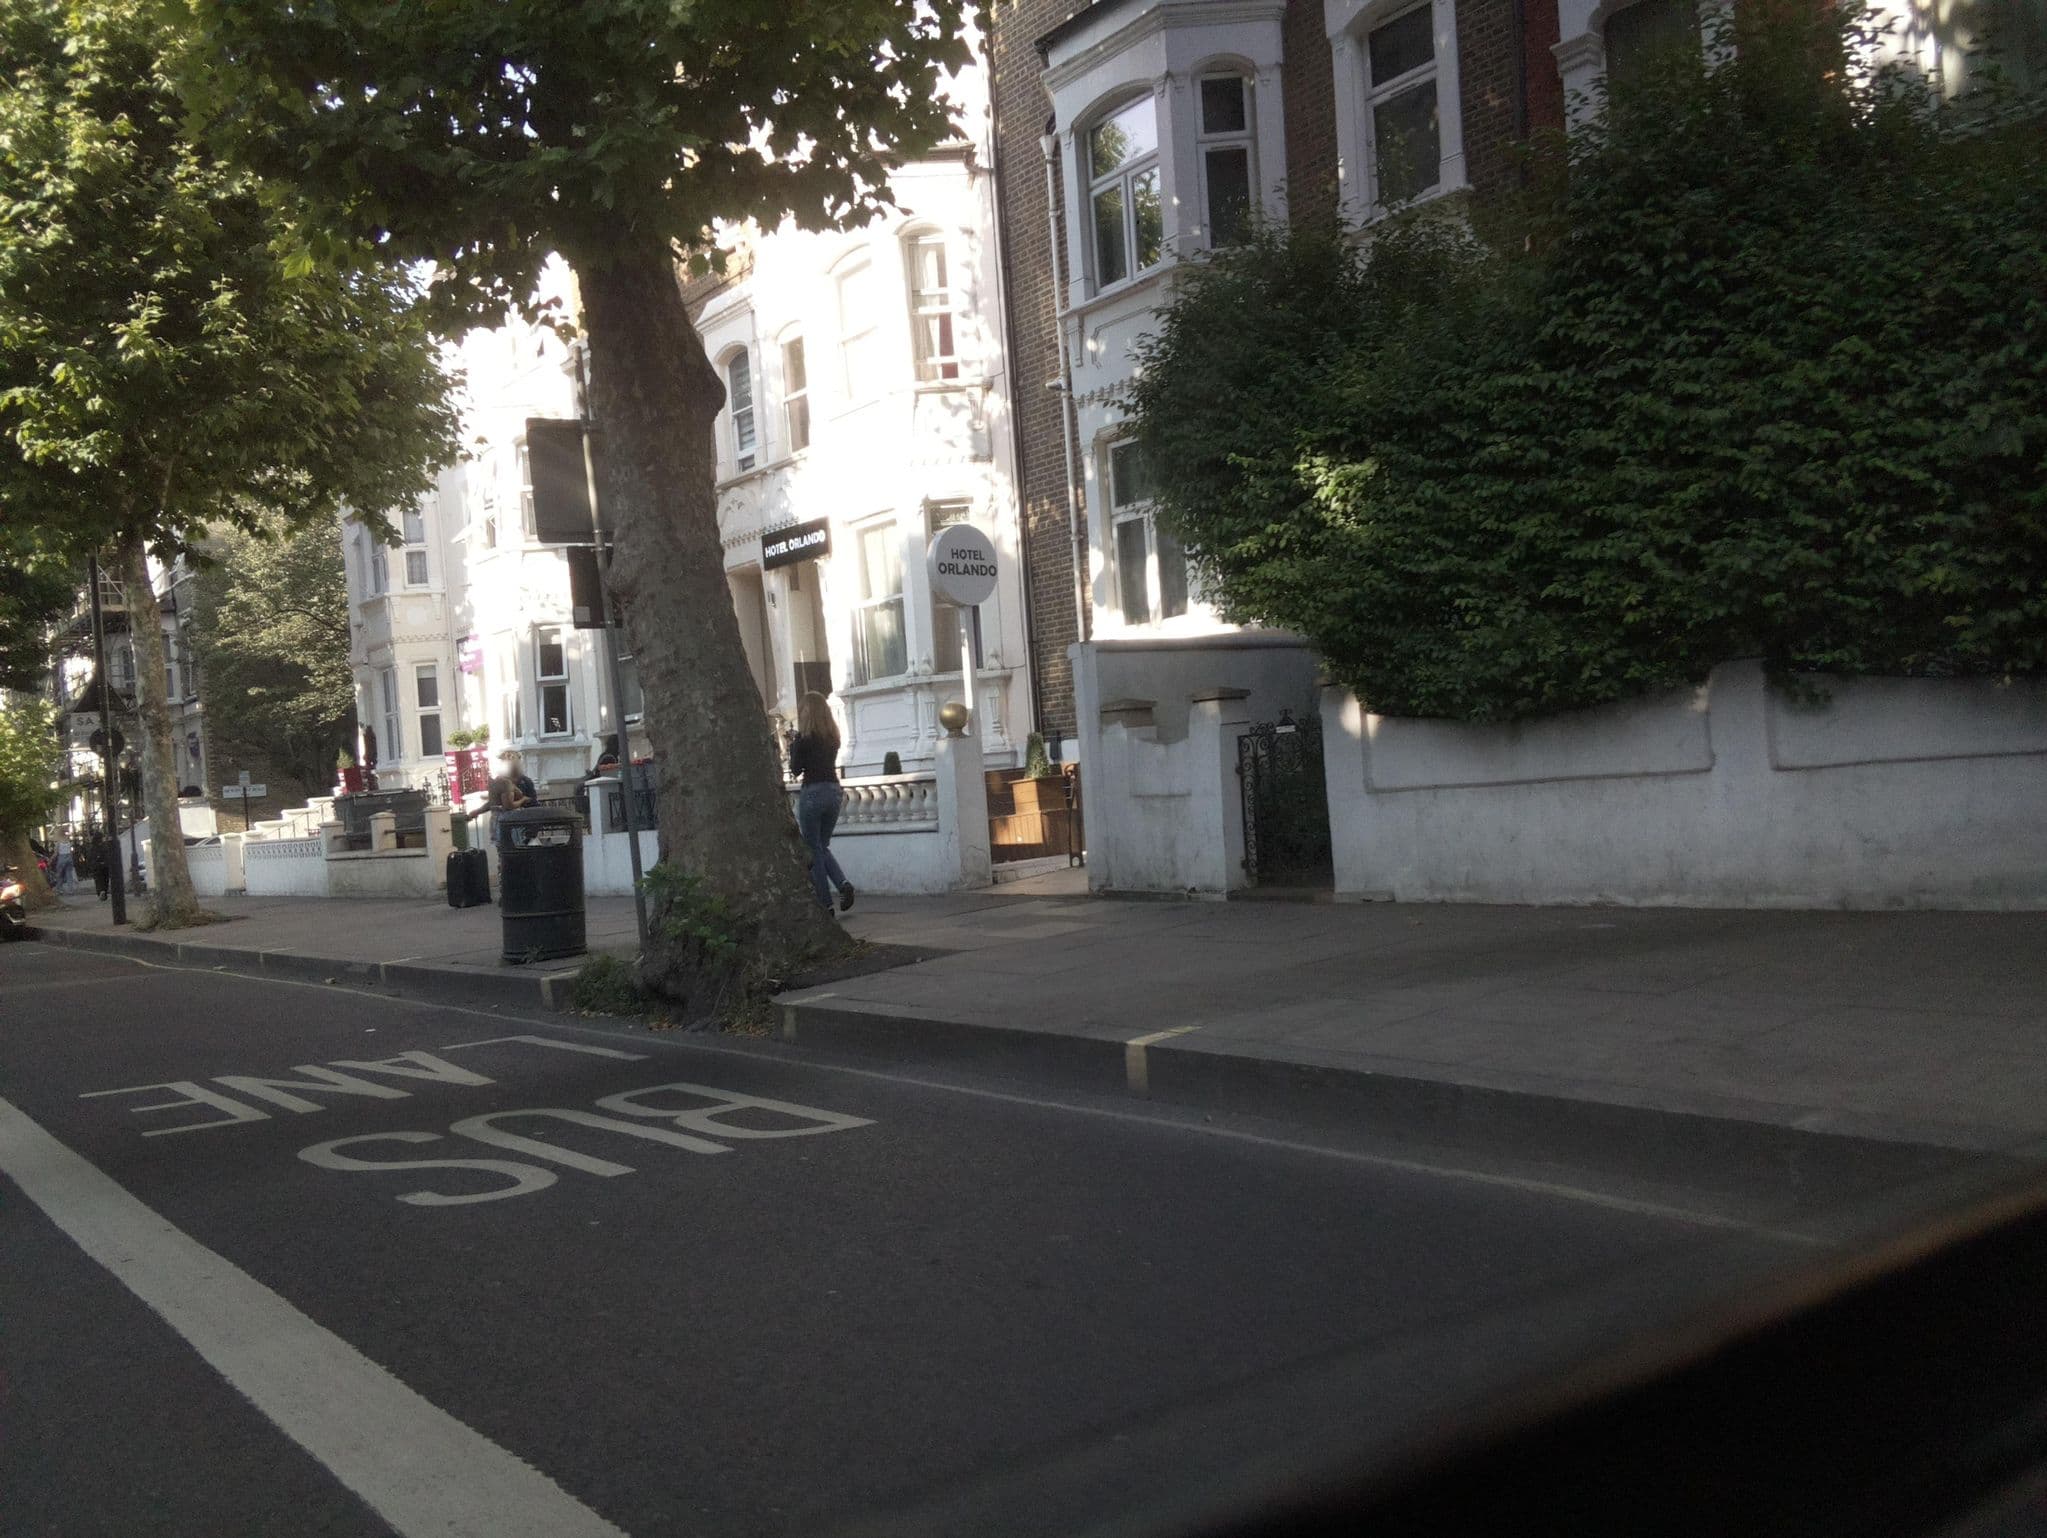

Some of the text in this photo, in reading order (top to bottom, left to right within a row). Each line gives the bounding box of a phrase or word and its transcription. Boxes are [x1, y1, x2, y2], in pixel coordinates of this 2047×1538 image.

[765, 529, 826, 558] HOTEL ORLANDO
[951, 548, 985, 561] HOTEL
[938, 562, 997, 577] ORLANDO
[79, 1035, 650, 1137] LANE
[298, 1082, 877, 1206] BUS
